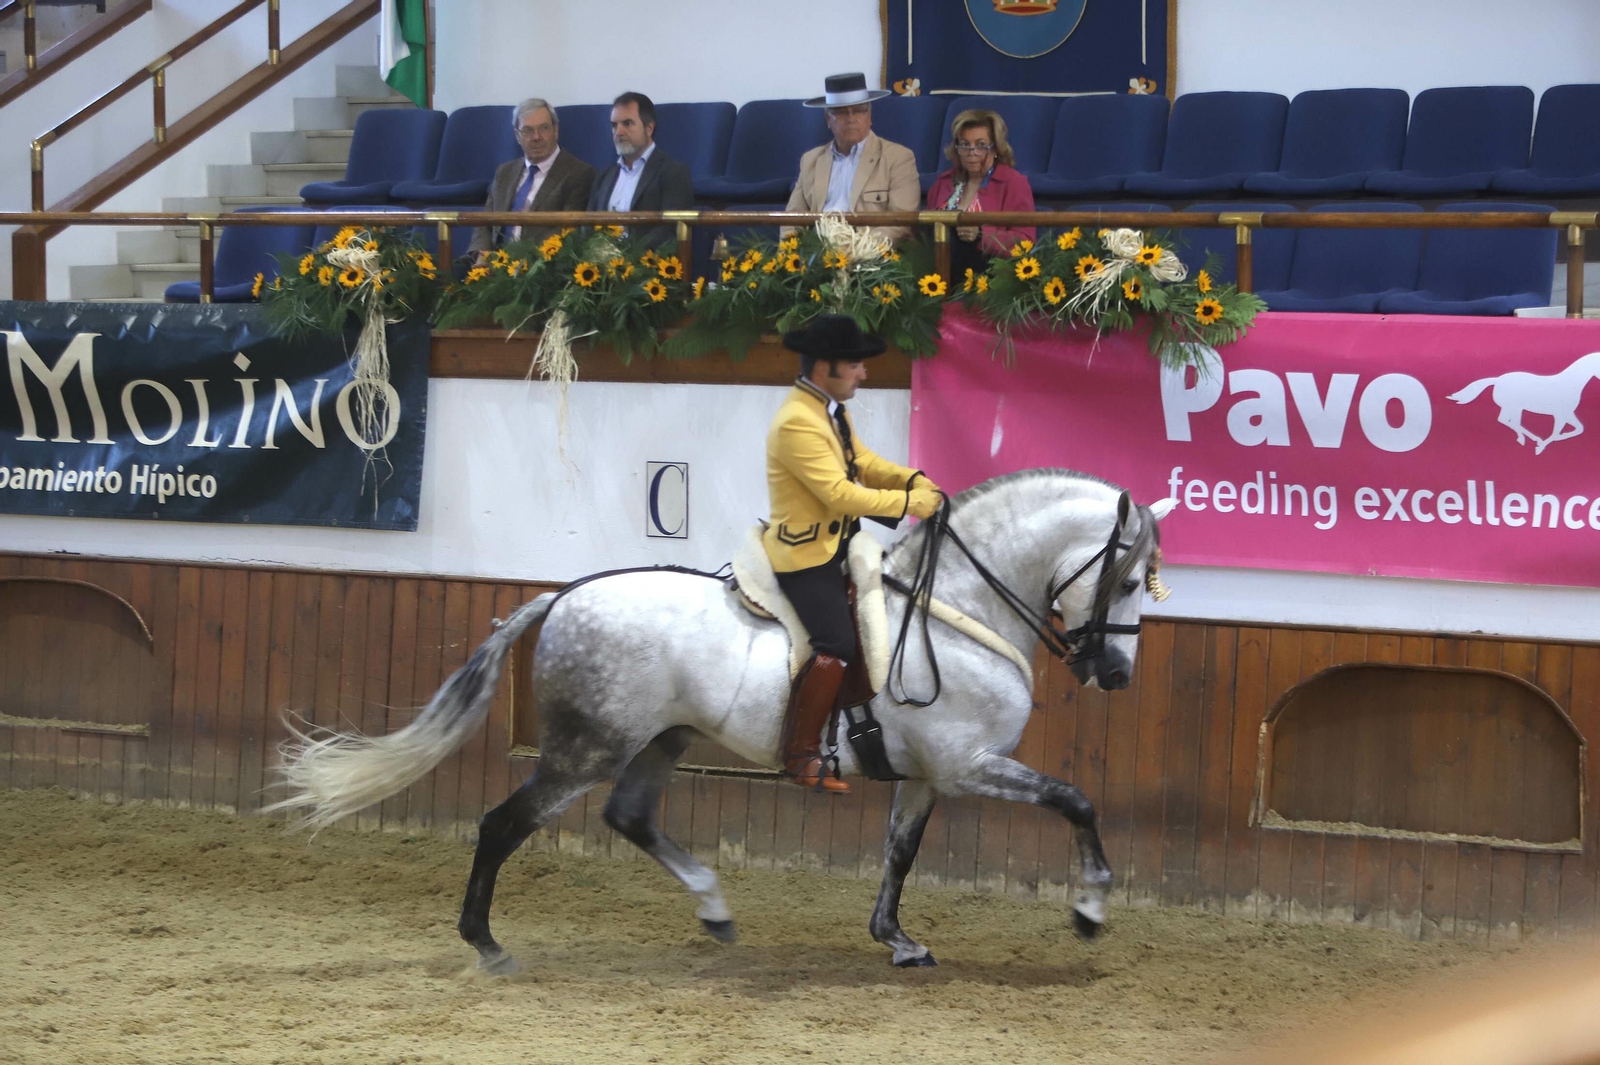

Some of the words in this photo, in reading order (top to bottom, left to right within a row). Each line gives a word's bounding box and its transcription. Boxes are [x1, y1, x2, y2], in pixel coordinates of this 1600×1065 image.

[1160, 342, 1432, 452] Pavo
[130, 464, 217, 503] Hípico
[649, 464, 686, 535] C
[1167, 466, 1338, 530] feeding
